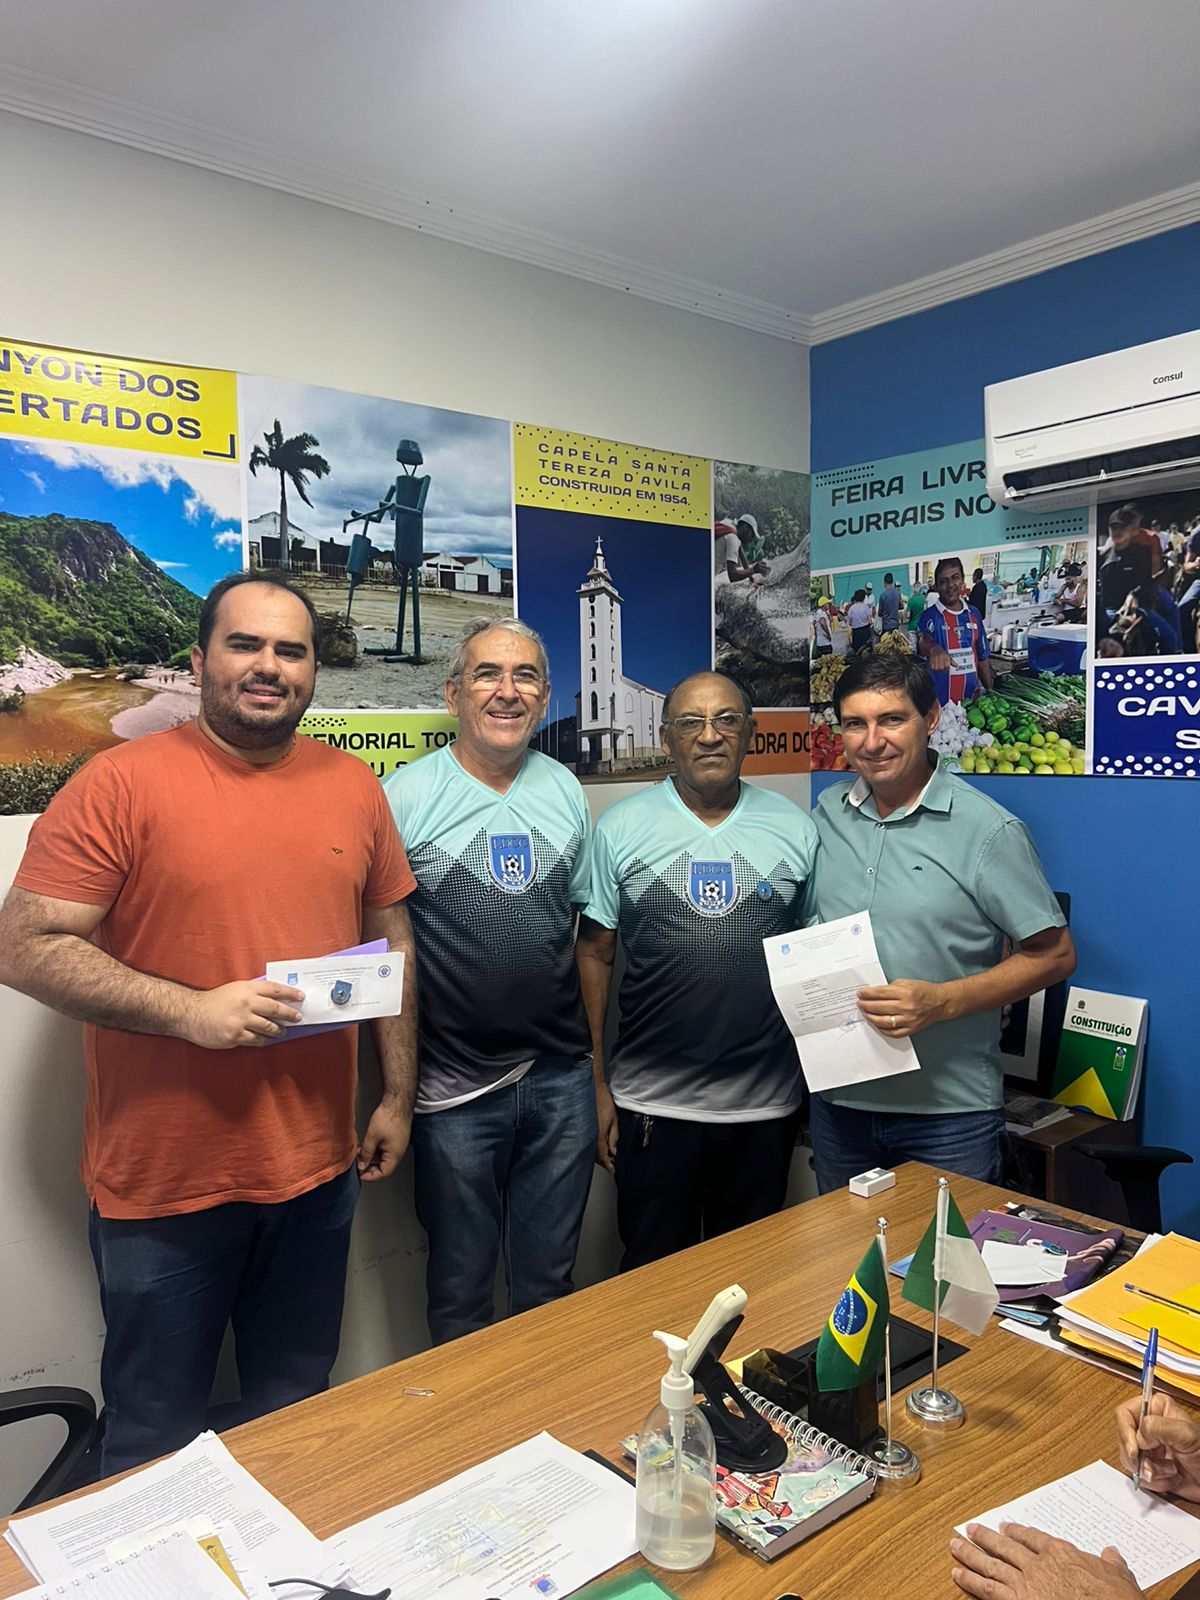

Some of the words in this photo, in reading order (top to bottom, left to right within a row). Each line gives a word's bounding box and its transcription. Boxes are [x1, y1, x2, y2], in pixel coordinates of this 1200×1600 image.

[119, 368, 200, 402] DOS
[538, 443, 618, 465] CAPELA
[632, 459, 690, 477] SANTA
[538, 458, 611, 479] TEREZA
[539, 474, 632, 498] CONSTRUIDA
[636, 489, 656, 501] EM
[659, 493, 691, 506] 1954.
[831, 475, 904, 507] FEIRA
[830, 502, 945, 538] CURRAIS
[955, 493, 1009, 518] NO
[746, 731, 787, 754] DRA
[1071, 1015, 1132, 1037] CONSTITUIÇÃO
